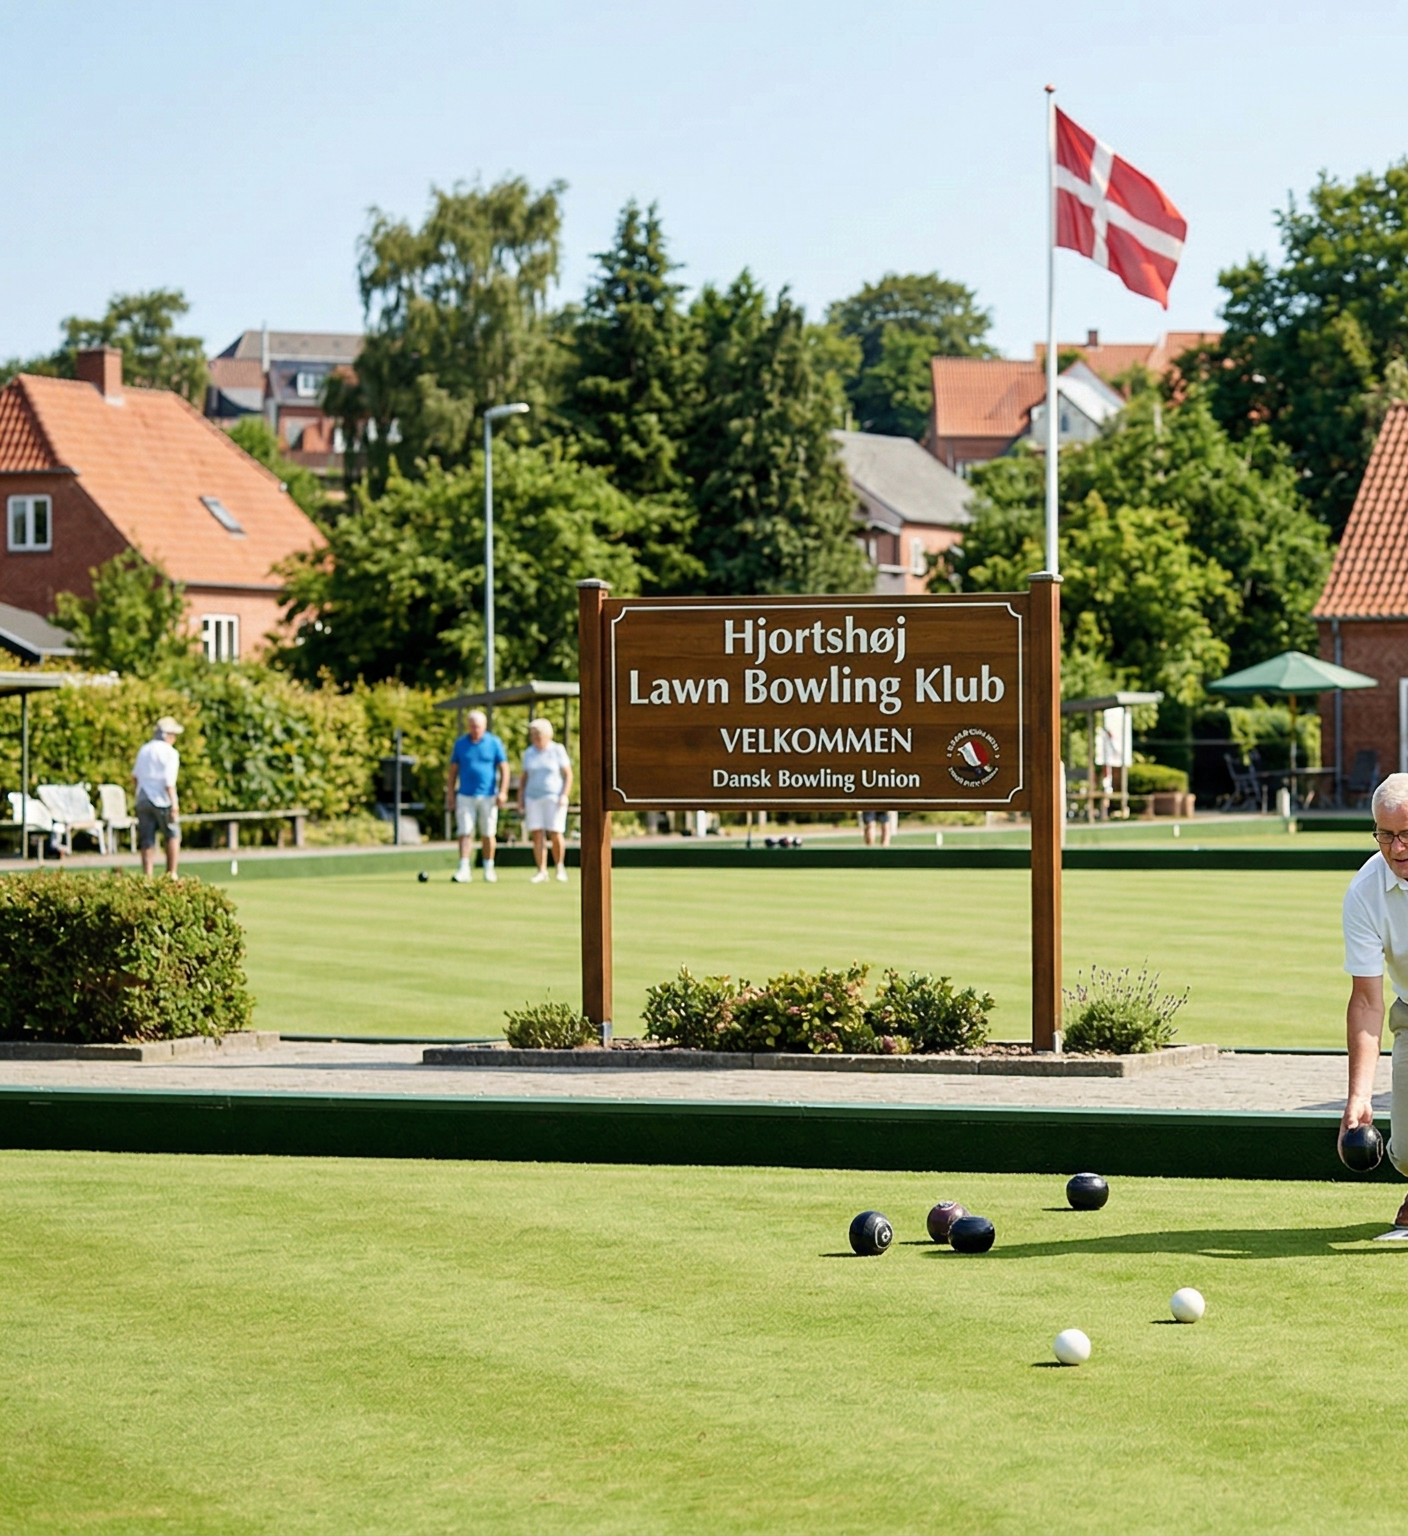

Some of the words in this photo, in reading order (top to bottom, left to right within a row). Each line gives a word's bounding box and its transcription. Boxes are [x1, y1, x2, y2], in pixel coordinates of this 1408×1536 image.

[724, 615, 906, 665] Hjortshøj
[630, 669, 729, 705] Lawn
[744, 665, 902, 715] Bowling
[915, 664, 1005, 703] Klub
[719, 727, 912, 754] VELKOMMEN
[712, 768, 772, 788] Dansk
[778, 768, 856, 793] Bowling
[861, 768, 920, 788] Union
